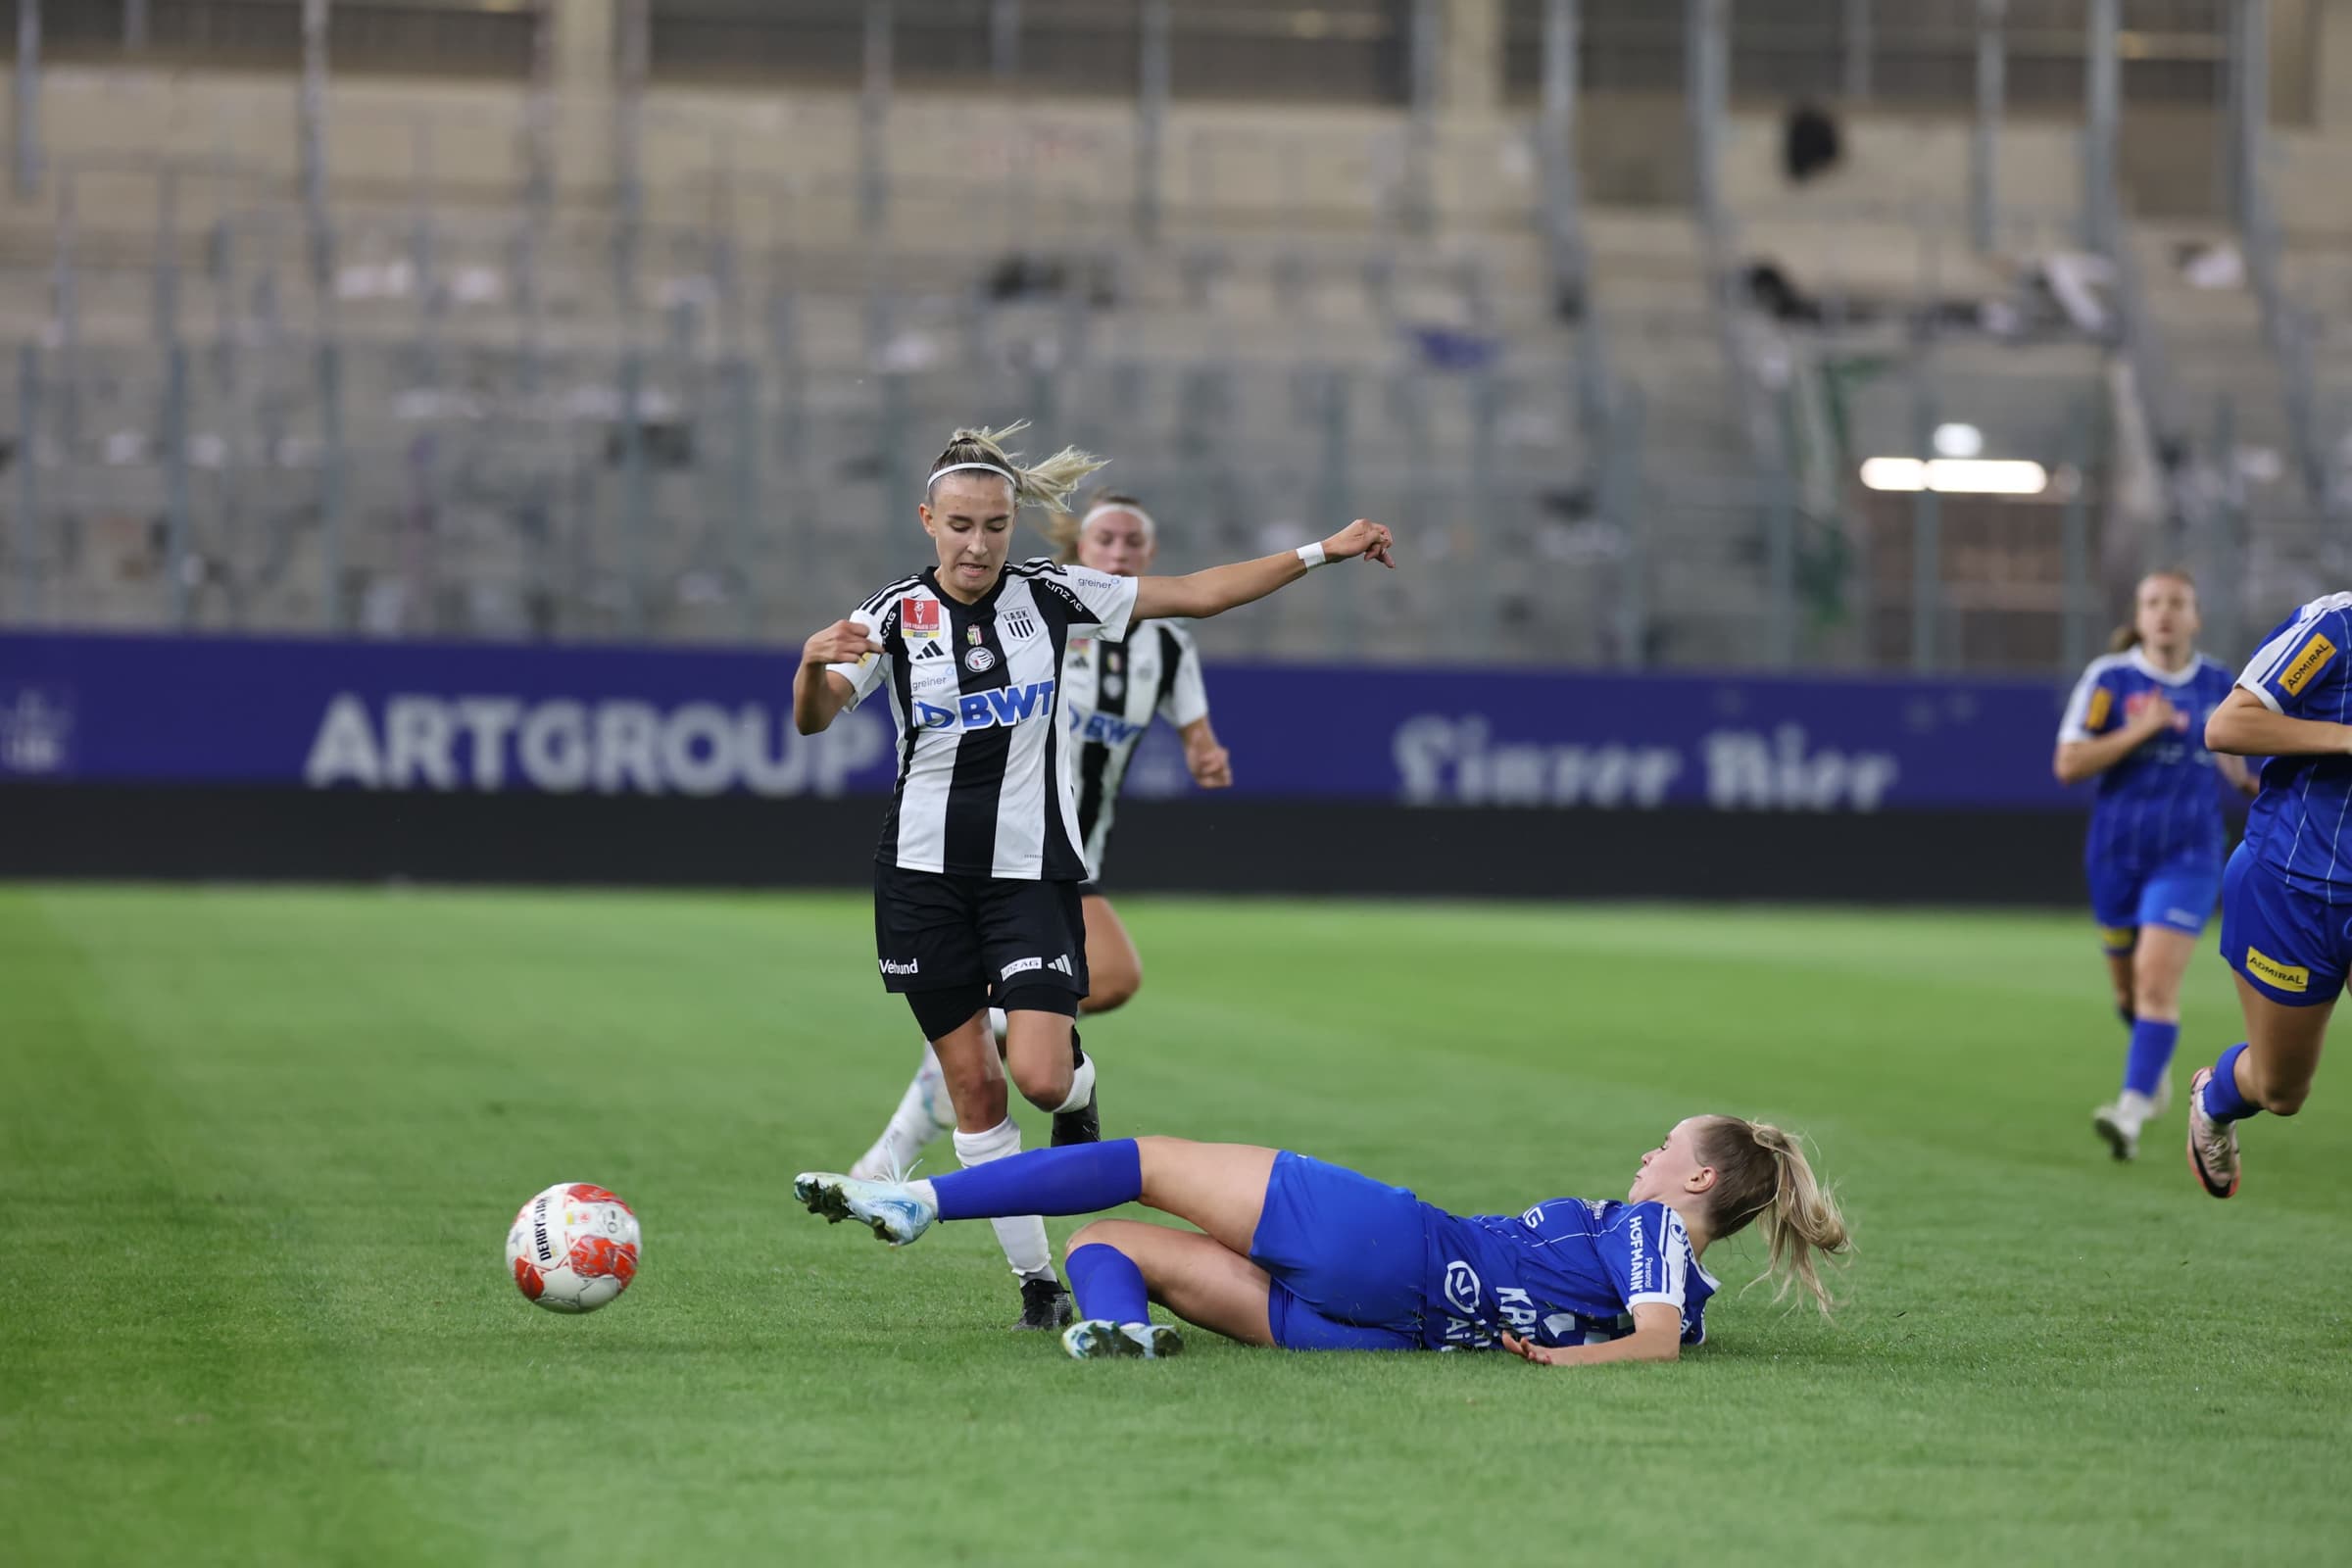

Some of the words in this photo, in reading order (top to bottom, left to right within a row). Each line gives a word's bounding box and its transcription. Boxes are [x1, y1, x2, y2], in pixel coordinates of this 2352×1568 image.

[1078, 577, 1112, 589] greiner
[1003, 610, 1028, 621] LASK
[2287, 643, 2329, 690] ADMIRAL
[912, 676, 947, 692] greiner
[957, 678, 1054, 729] BWT
[2249, 956, 2304, 985] ADMIRAL
[1629, 1215, 1644, 1292] HOFMANN
[1644, 1257, 1654, 1289] Personal
